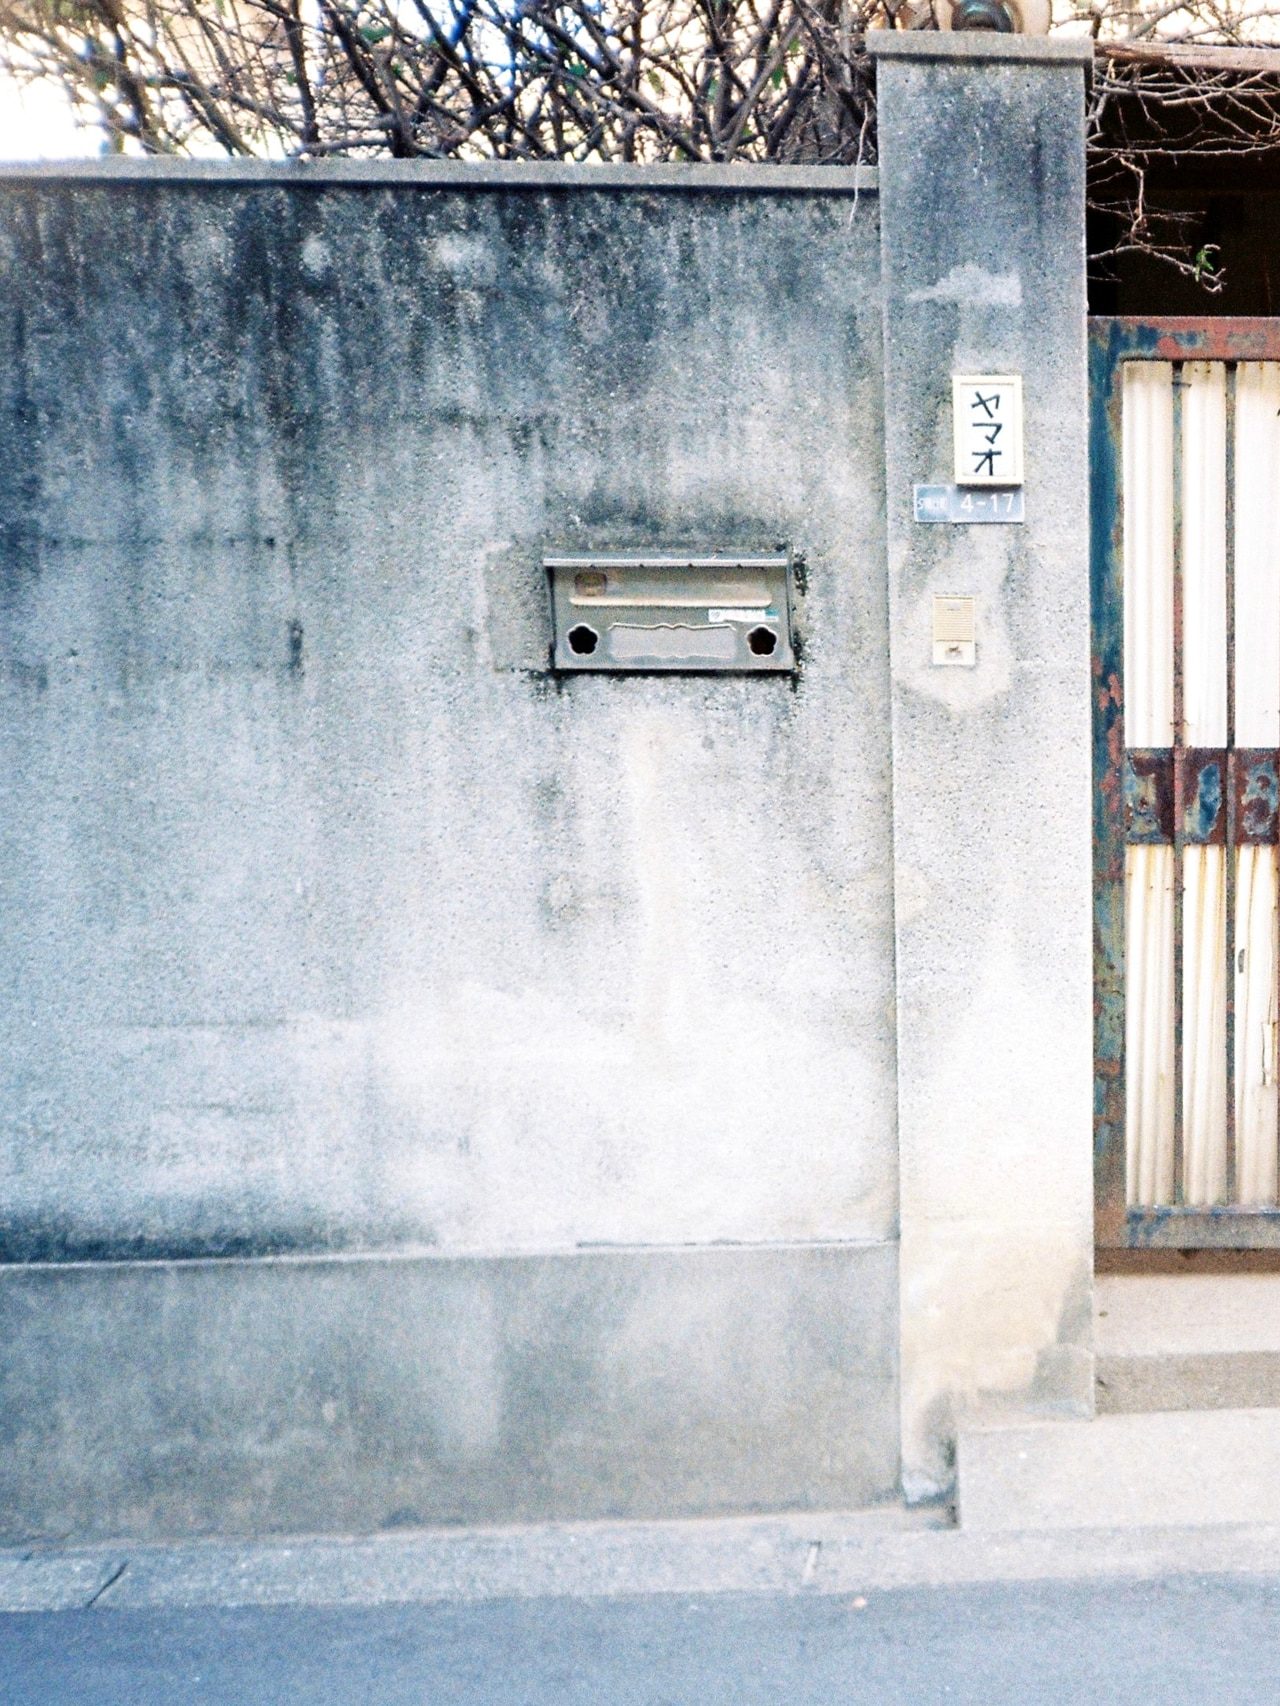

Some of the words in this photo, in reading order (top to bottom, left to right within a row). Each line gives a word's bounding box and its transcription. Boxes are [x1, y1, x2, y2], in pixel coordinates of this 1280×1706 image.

[971, 391, 1003, 476] ヤマオ
[960, 493, 1014, 513] 4-17
